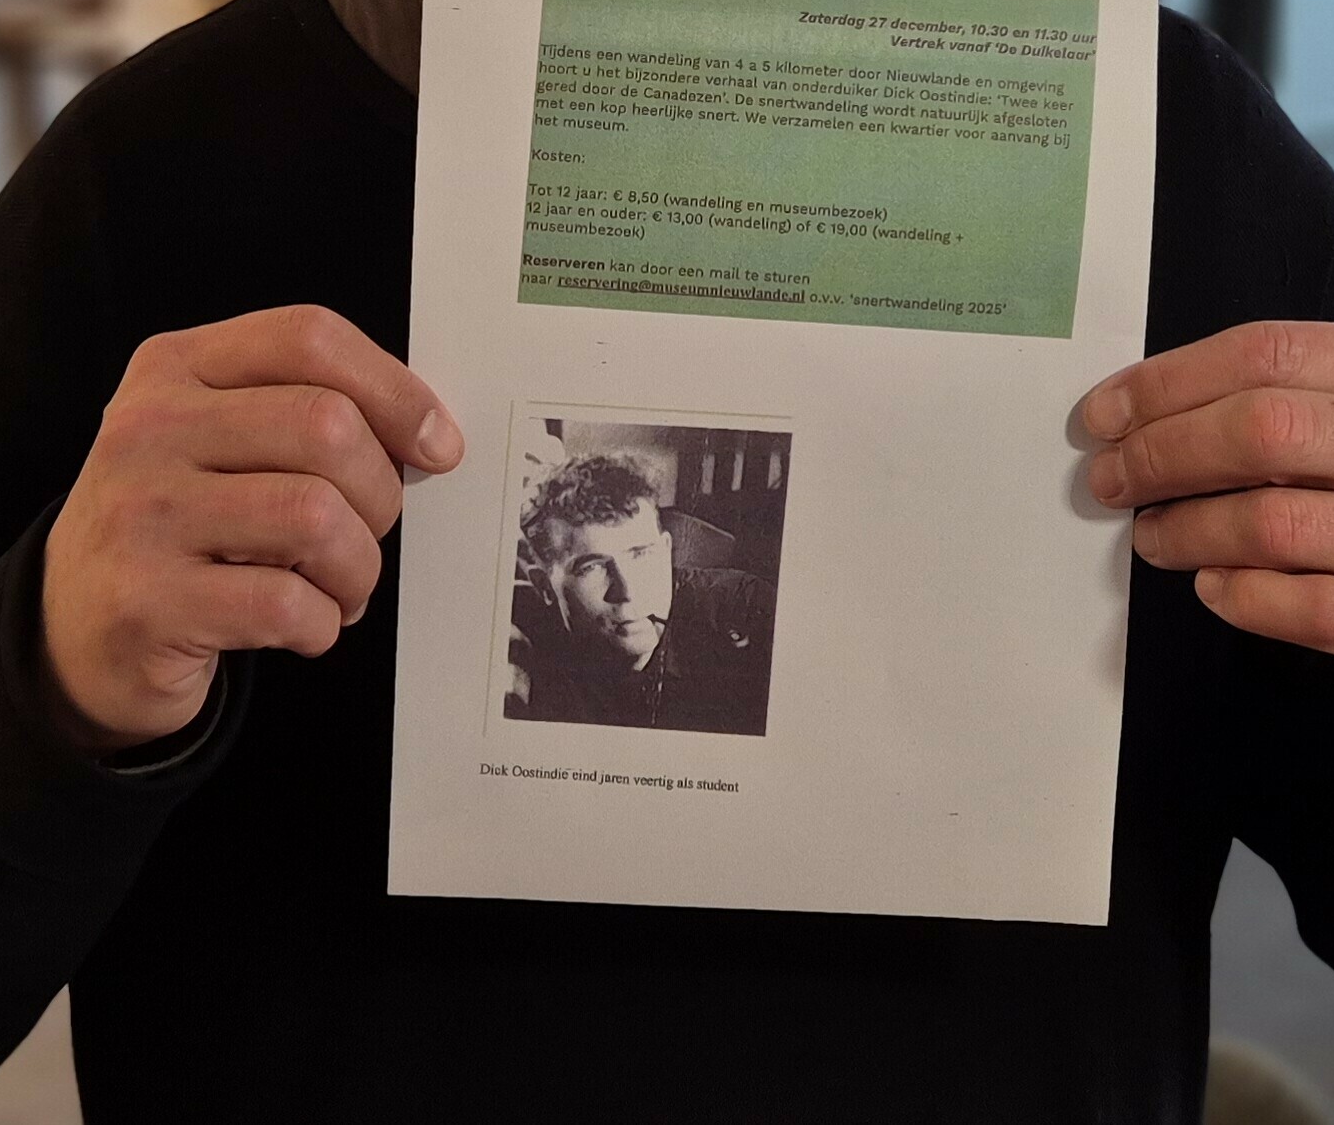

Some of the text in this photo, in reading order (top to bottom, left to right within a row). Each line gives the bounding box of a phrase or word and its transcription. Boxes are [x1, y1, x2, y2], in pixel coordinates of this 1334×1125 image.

[799, 12, 1096, 43] Zaterdag 27 december, 10.30 en 11.30 uur
[891, 35, 945, 49] Vertrek
[950, 42, 992, 53] vanaf
[538, 61, 577, 75] hoort
[583, 67, 591, 76] u
[597, 65, 620, 78] het
[626, 67, 700, 84] bijzondere
[706, 75, 757, 88] verhaal
[763, 81, 787, 90] van
[793, 81, 878, 96] onderduiker
[884, 86, 914, 99] Dick
[1044, 98, 1074, 110] keer
[539, 44, 1064, 96] Tijdens een wandeling van 4 a 5 kilometer door Nieuwlande en omgeving
[536, 81, 576, 94] gered
[582, 82, 615, 95] door
[621, 85, 638, 97] de
[735, 93, 753, 105] De
[759, 98, 868, 117] snertwandeling
[873, 105, 915, 117] wordt
[920, 109, 988, 125] natuurlijk
[994, 112, 1067, 128] afgesloten
[534, 113, 629, 131] het museum.
[535, 96, 1070, 149] met een kop heerlijke snert. We verzamelen een kwartier voor aanvang bij
[531, 148, 585, 163] Kosten:
[529, 183, 887, 222] Tot 12 jaar: € 8,50 (wandeling en museumbezoek)
[525, 221, 645, 240] museumbezoek)
[526, 202, 540, 214] 12
[545, 203, 572, 217] jaar
[578, 207, 595, 217] en
[600, 208, 646, 221] ouder:
[652, 211, 662, 222] €
[668, 212, 703, 225] 13,00
[709, 214, 791, 234] (wandeling)
[796, 220, 811, 232] of
[817, 222, 826, 233] €
[831, 223, 867, 237] 19,00
[873, 225, 951, 245] (wandeling
[523, 254, 810, 284] Reserveren kan door een mail te sturen
[521, 273, 552, 284] naar
[557, 276, 805, 303] reservering@museumnieuwlande.nl
[810, 294, 844, 304] o.v.v.
[480, 763, 508, 776] Dick
[572, 769, 597, 781] eind
[599, 772, 629, 785] jaren
[634, 775, 673, 790] veertig
[677, 777, 693, 789] als
[697, 779, 738, 792] student
